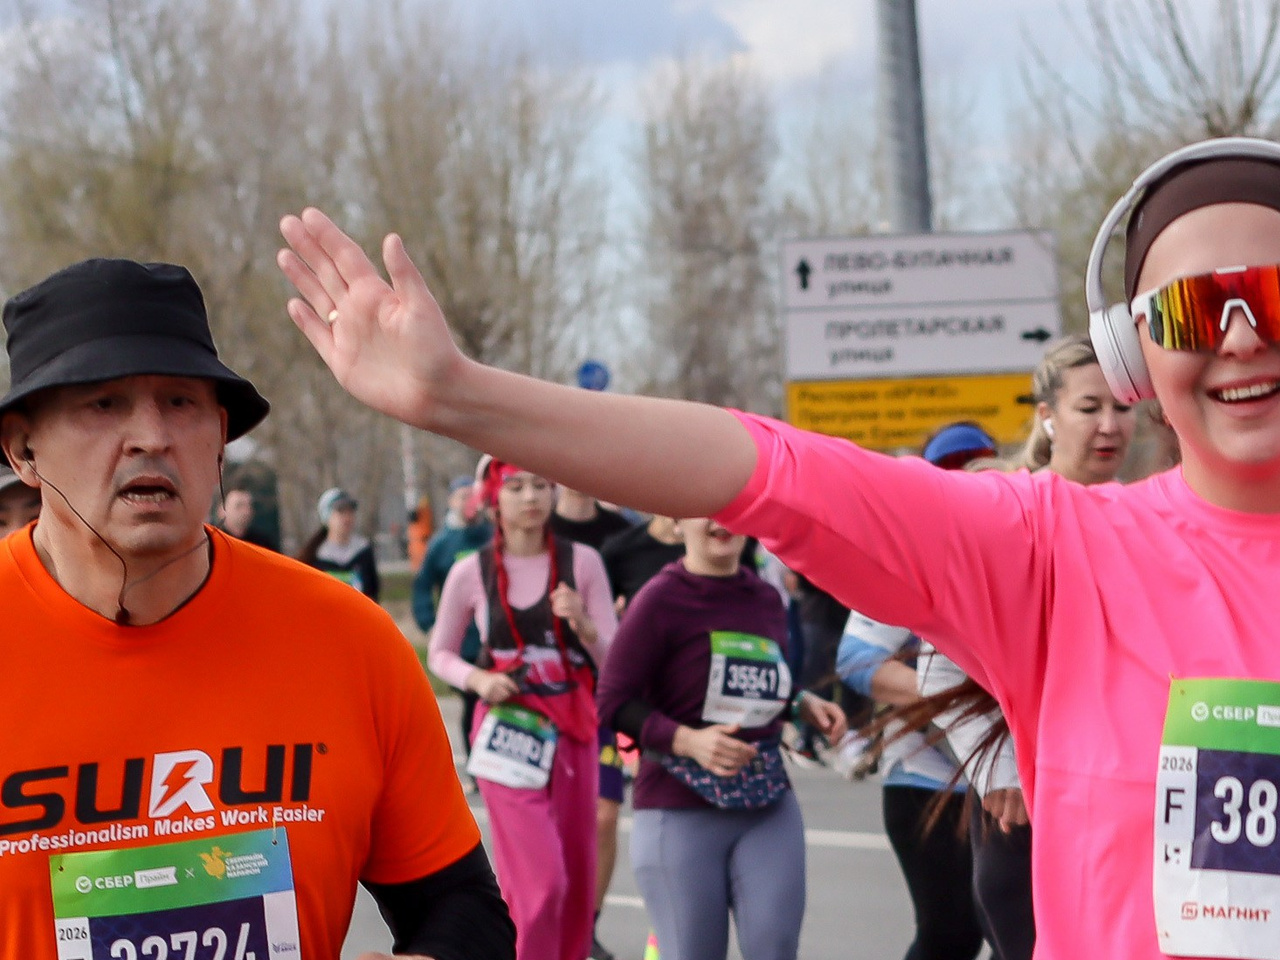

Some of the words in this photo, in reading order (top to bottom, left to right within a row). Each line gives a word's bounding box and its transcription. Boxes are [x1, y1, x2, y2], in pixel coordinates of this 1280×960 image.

[828, 279, 892, 297] улица
[825, 315, 1005, 339] ПРОЛЕТАРСКАЯ
[830, 348, 893, 366] улица
[727, 664, 777, 693] 35541
[1212, 705, 1255, 720] СБЕР
[1161, 756, 1194, 772] 2026
[0, 743, 313, 835] SURUI
[1165, 788, 1185, 823] F
[0, 824, 149, 857] Professionalism
[154, 814, 215, 836] Makes
[220, 806, 268, 826] Work
[273, 804, 325, 822] Easier
[95, 875, 133, 889] СБЕР
[1203, 905, 1271, 921] МАГНИТ
[58, 927, 88, 941] 2026
